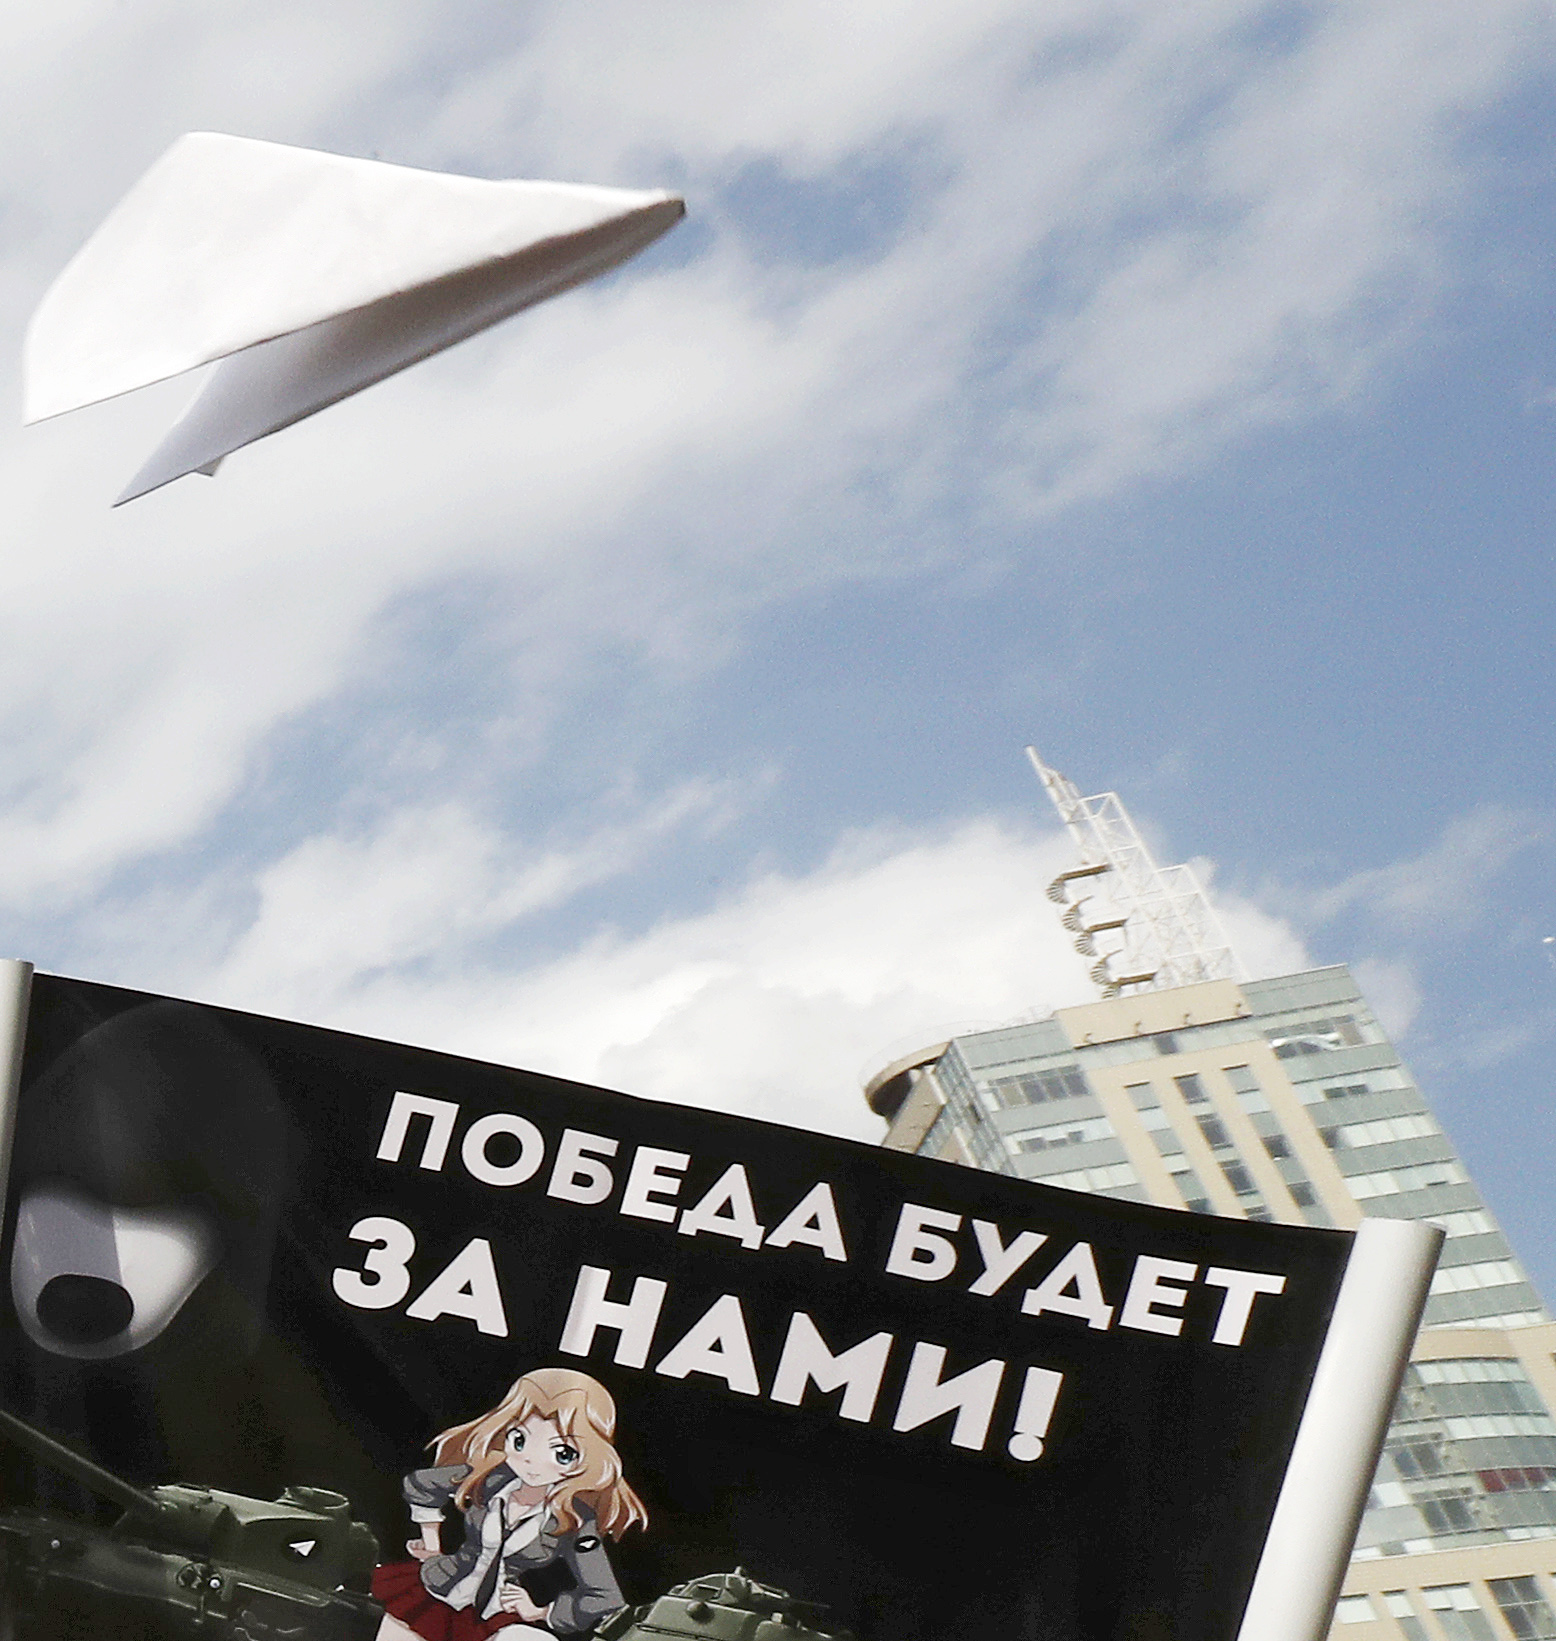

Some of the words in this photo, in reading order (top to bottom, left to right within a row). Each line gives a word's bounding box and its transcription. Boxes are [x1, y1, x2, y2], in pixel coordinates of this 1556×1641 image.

[331, 1215, 509, 1338] ЗА
[557, 1266, 1064, 1463] НАМИ!
[374, 1090, 849, 1263] ПОБЕДА
[886, 1202, 1286, 1347] БУДЕТ
